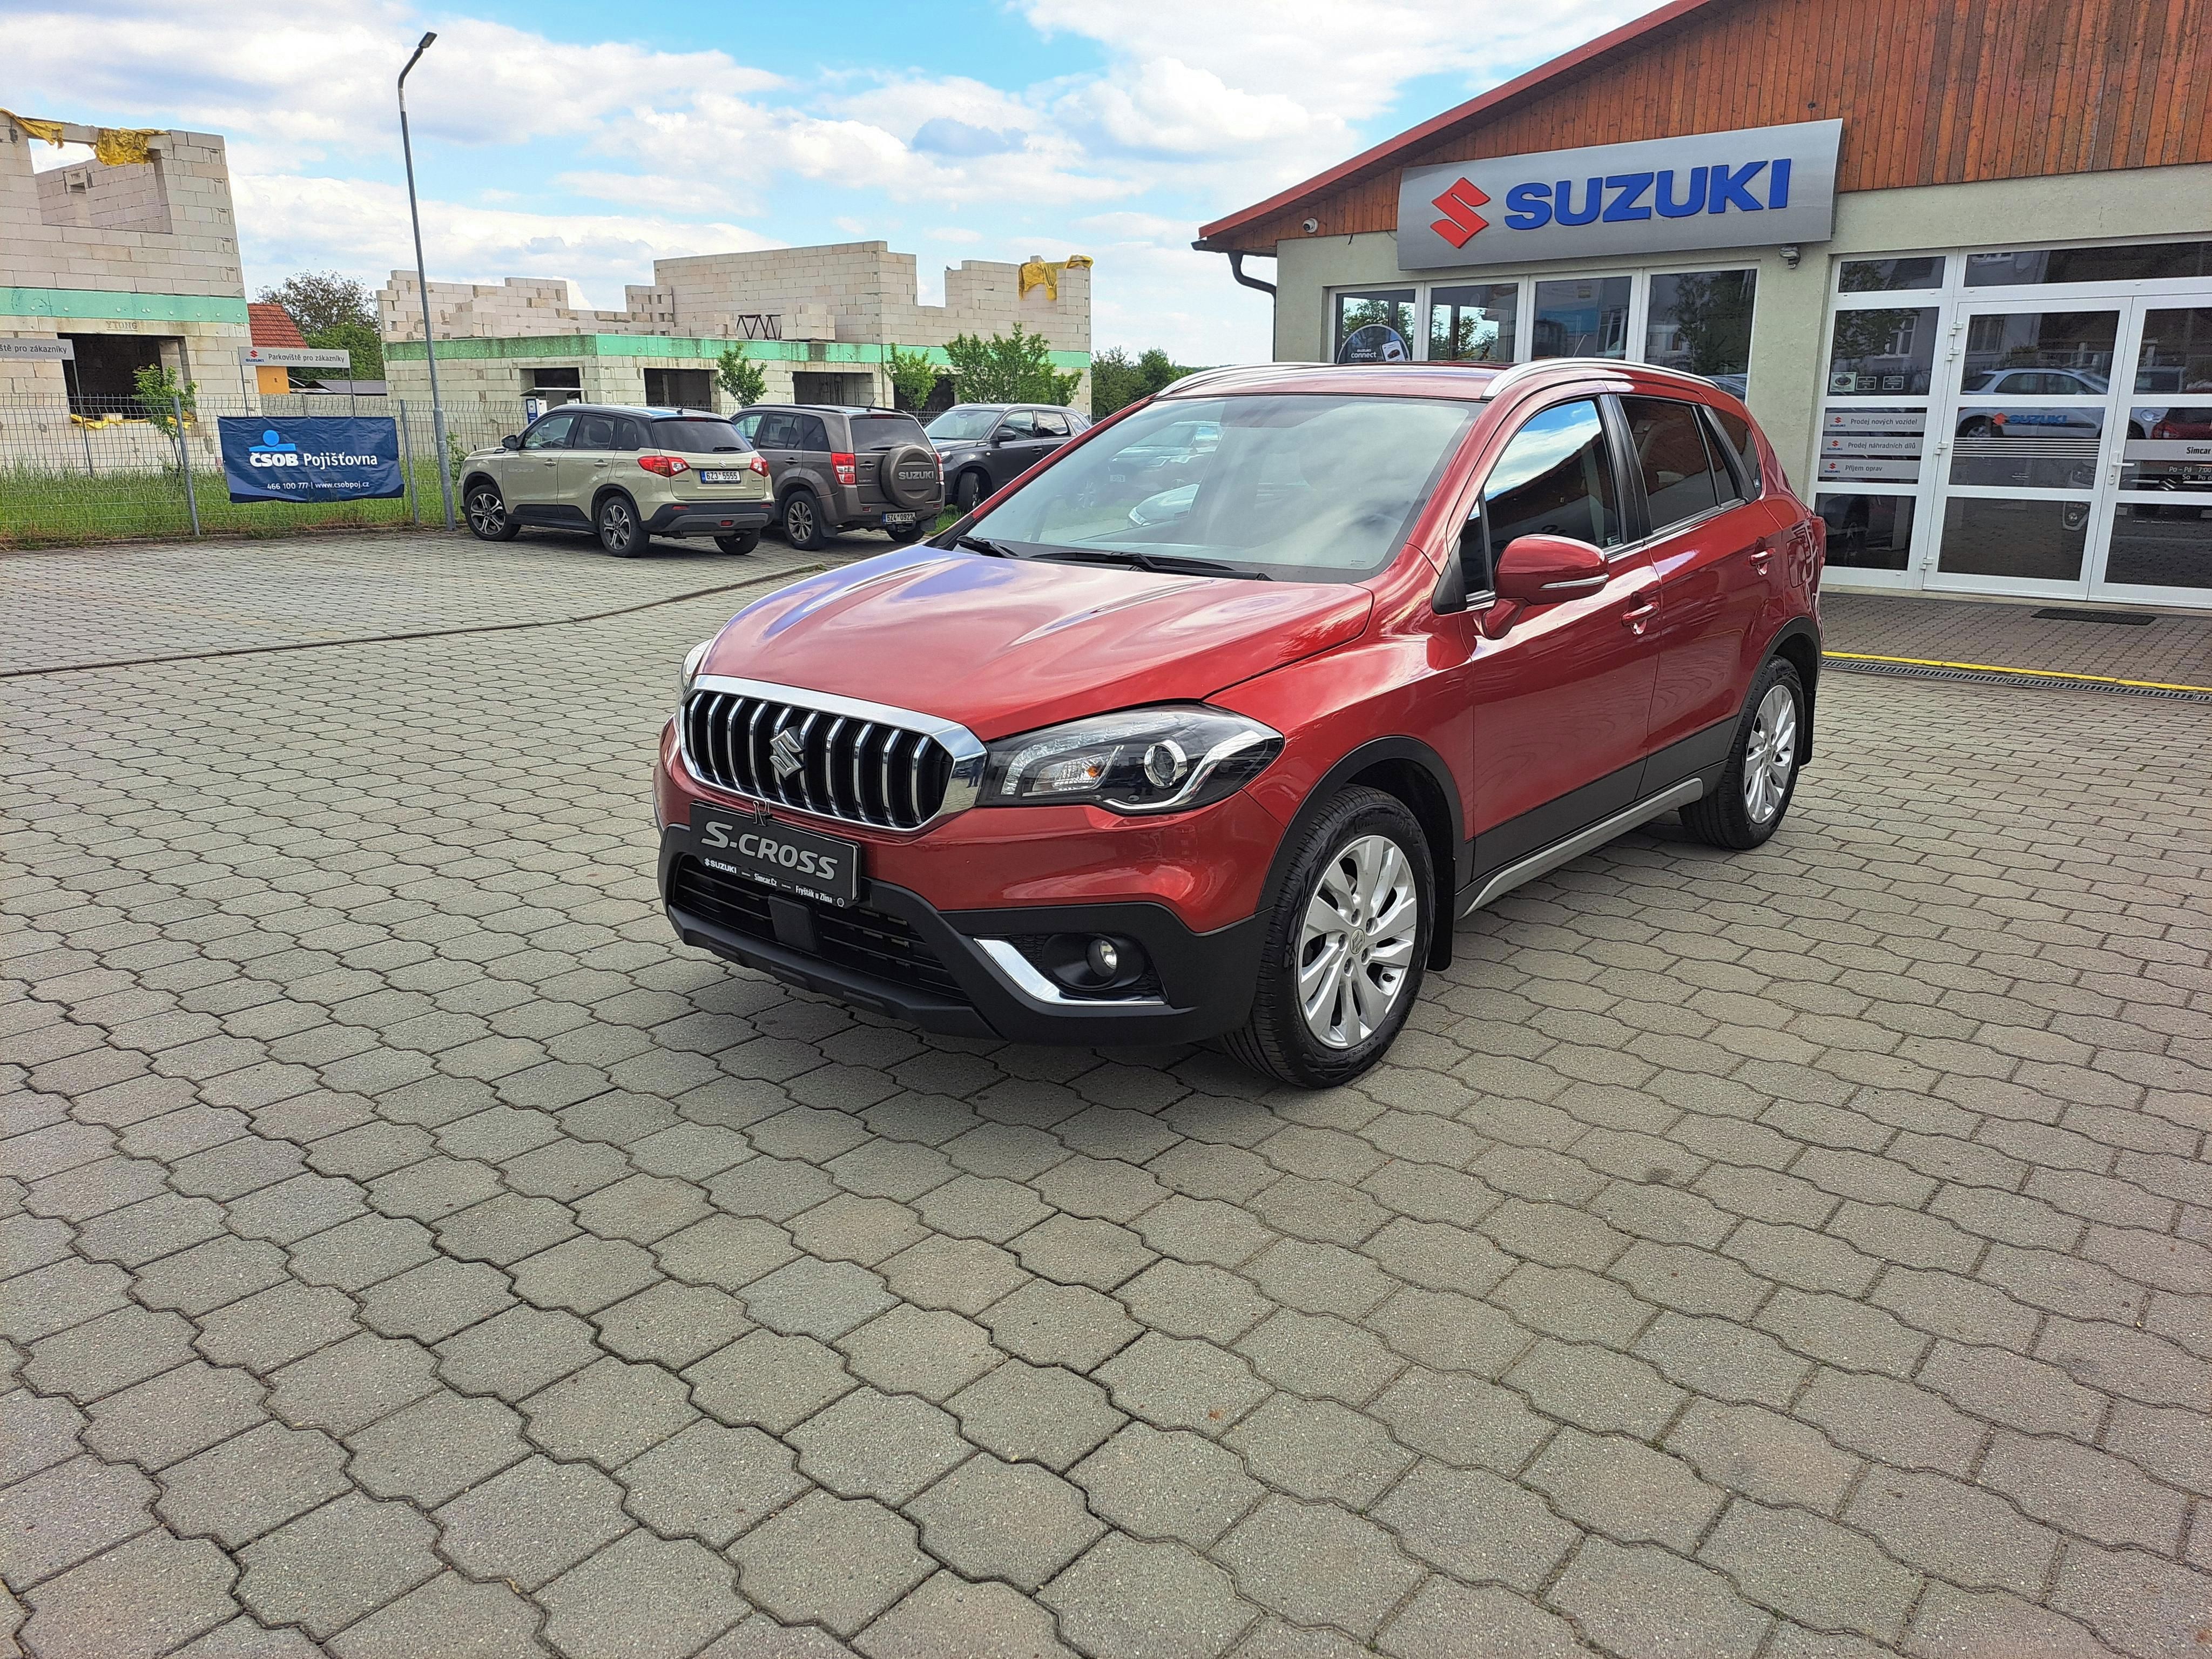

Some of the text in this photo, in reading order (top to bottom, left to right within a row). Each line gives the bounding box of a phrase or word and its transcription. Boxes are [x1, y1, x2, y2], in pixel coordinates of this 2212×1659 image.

[1504, 158, 1791, 231] SUZUKI
[106, 321, 138, 329] YTONG
[30, 345, 67, 354] zákazníky
[2009, 415, 2067, 424] SUZUKI
[249, 451, 377, 470] ČSOB Pojišťovna
[898, 471, 934, 480] SUZUKI
[315, 481, 370, 489] www.csobpoj.cz
[710, 860, 737, 874] SUZUKI
[795, 885, 814, 898] Fryšták
